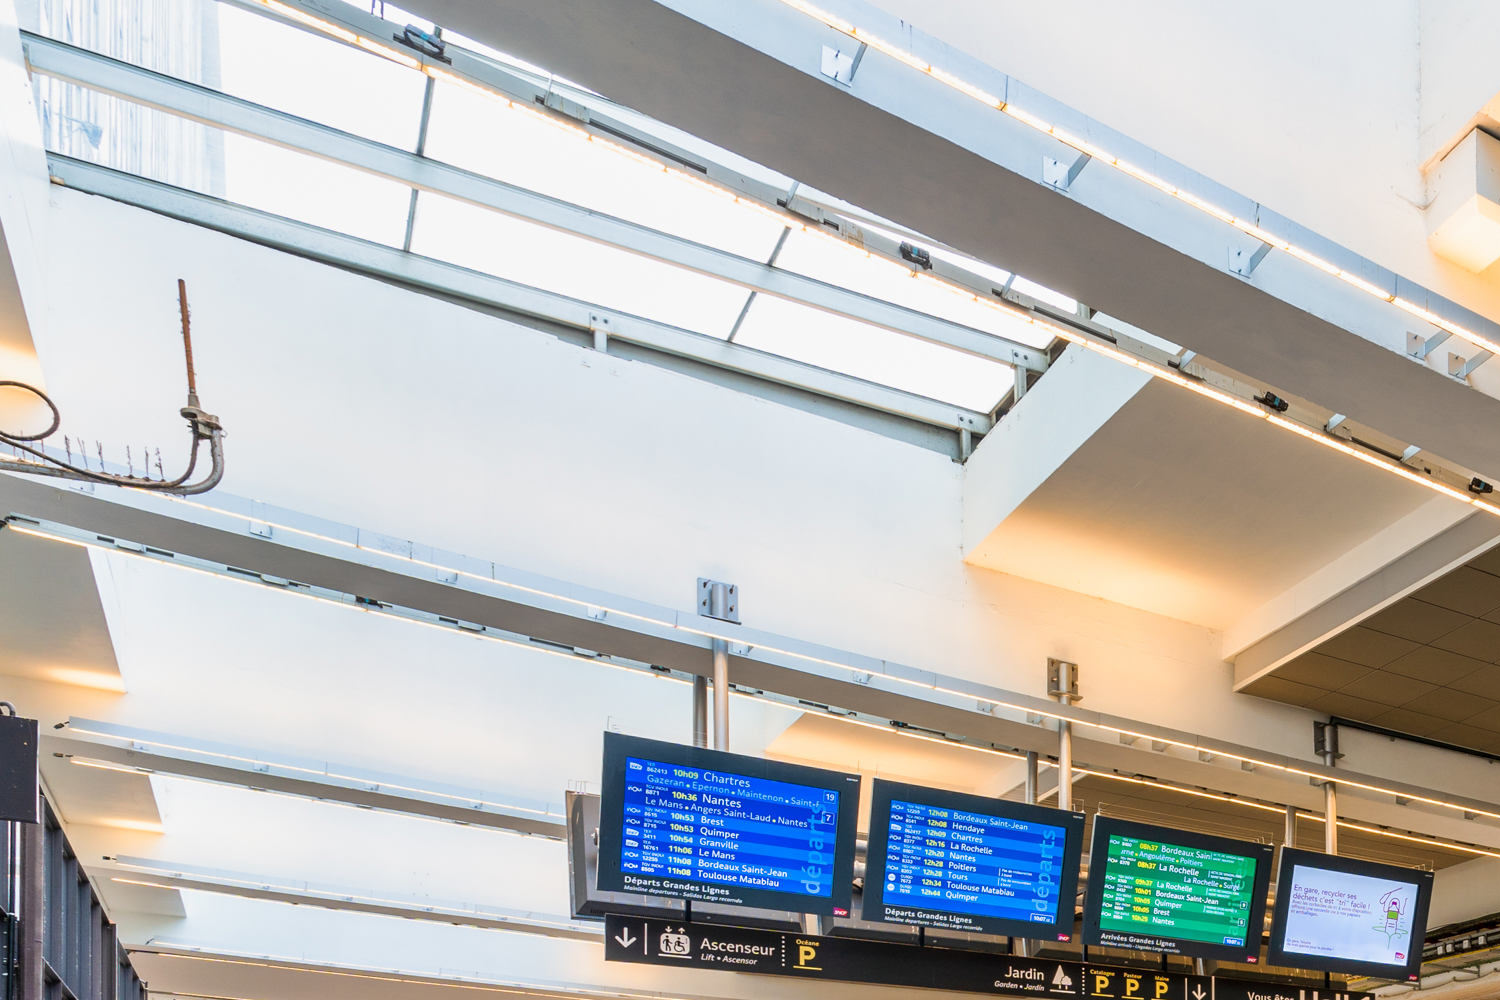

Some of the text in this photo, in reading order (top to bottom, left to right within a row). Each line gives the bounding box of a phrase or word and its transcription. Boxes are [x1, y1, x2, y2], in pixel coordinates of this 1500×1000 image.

[673, 769, 699, 779] 10h09
[704, 772, 751, 788] Chartres
[647, 774, 784, 802] Gazeran Epernon Maintenon
[672, 791, 698, 802] 10h36
[702, 794, 742, 808] Nantes
[646, 797, 808, 828] Le Mans Angers Saint-Laud Nantes
[671, 813, 694, 822] 10h53
[928, 809, 948, 818] 12h08
[701, 816, 724, 827] Brest
[928, 819, 948, 828] 12h08
[954, 812, 1028, 831] Bordeaux Saint-Jean
[670, 824, 694, 833] 10h53
[700, 827, 740, 840] Quimper
[927, 829, 947, 838] 12h09
[952, 822, 985, 834] Hendaye
[670, 835, 694, 844] 10h54
[700, 838, 739, 850] Granville
[926, 839, 946, 848] 12h16
[951, 832, 983, 844] Chartres
[669, 846, 693, 854] 11h06
[699, 848, 736, 860] Le Mans
[801, 804, 828, 894] départs
[925, 849, 945, 858] 12h20
[950, 842, 993, 855] La Rochelle
[1161, 845, 1194, 857] Bordeaux
[668, 856, 692, 865] 11h08
[950, 852, 976, 862] Nantes
[1139, 851, 1176, 863] Angoulême
[1180, 857, 1204, 867] Poitiers
[698, 859, 788, 878] Bordeaux Saint-Jean
[924, 859, 944, 868] 12h28
[949, 862, 977, 872] Poitiers
[1159, 863, 1168, 872] La
[1169, 865, 1199, 876] Rochelle
[667, 867, 692, 876] 11h08
[923, 869, 942, 877] 12h28
[948, 872, 968, 881] Tours
[1032, 830, 1056, 912] départs
[697, 870, 780, 887] Toulouse Matabiau
[922, 879, 942, 887] 12h34
[1192, 877, 1219, 887] Rochelle
[624, 876, 730, 895] Départs Grandes Lignes
[947, 881, 1015, 896] Toulouse Matabiau
[1157, 881, 1192, 892] La Rochelle
[1294, 884, 1302, 892] En
[1304, 887, 1320, 895] gare,
[1322, 890, 1346, 898] recycler
[946, 891, 978, 902] Quimper
[1156, 890, 1219, 906] Bordeaux Saint-Jean
[1293, 892, 1318, 902] déchets
[1351, 900, 1367, 909] facile
[1155, 899, 1183, 909] Quimper
[885, 908, 972, 924] Départs Grandes Lignes
[1154, 908, 1170, 916] Brest
[1152, 917, 1175, 926] Nantes
[796, 939, 820, 947] Océane
[1101, 933, 1128, 942] Arrivées
[1129, 936, 1154, 945] Grandes
[1156, 940, 1176, 948] Lignes
[701, 938, 775, 957] Ascenseur
[701, 954, 758, 966] Lift Ascensor
[800, 945, 816, 966] P
[1004, 966, 1044, 981] Jardin
[1090, 969, 1115, 977] Catalogne
[1124, 972, 1142, 980] Pasteur
[994, 981, 1018, 989] Garden
[1096, 976, 1110, 994] P
[1126, 979, 1140, 996] P
[1156, 982, 1169, 999] P
